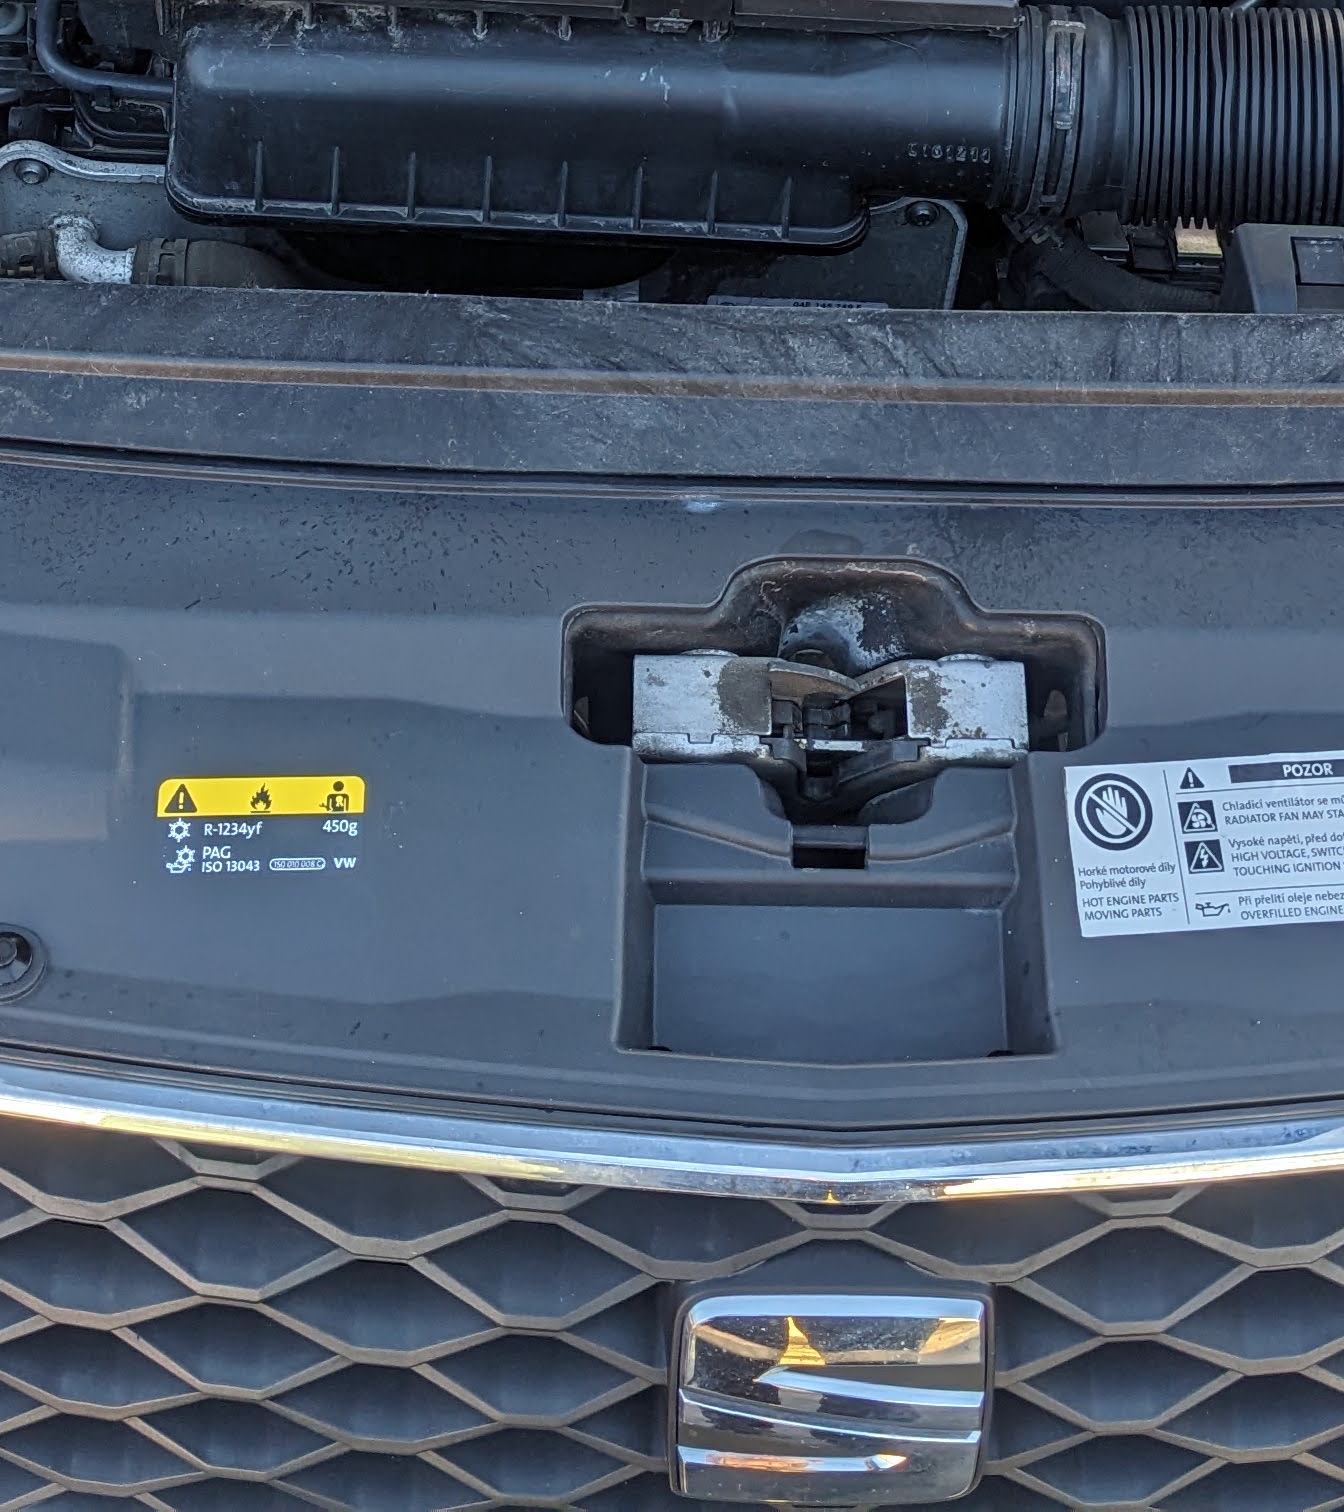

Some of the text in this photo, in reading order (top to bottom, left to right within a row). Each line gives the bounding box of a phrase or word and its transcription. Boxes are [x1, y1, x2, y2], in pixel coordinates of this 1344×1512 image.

[1281, 762, 1333, 778] POZOR
[1264, 796, 1315, 809] ventilátor
[1316, 797, 1329, 806] se
[1223, 812, 1276, 825] RADIATOR
[1278, 811, 1299, 821] FAN
[1301, 809, 1324, 820] MAY
[204, 820, 358, 839] R-1234yf 450g
[1227, 836, 1265, 849] Vysoké
[1266, 833, 1304, 848] napětí,
[1304, 832, 1328, 846] před
[202, 846, 231, 859] PAG
[1230, 851, 1259, 862] HIGH
[1260, 848, 1310, 861] VOLTAGE,
[202, 860, 260, 872] ISO 13043
[334, 857, 356, 869] VW
[1077, 861, 1176, 876] Horké motorové díly
[1232, 864, 1291, 876] TOUCHING
[1292, 861, 1341, 873] IGNITION
[1079, 876, 1147, 892] Pohyblivé díly
[1082, 892, 1179, 907] HOT ENGINE PARTS
[1238, 895, 1252, 907] Při
[1254, 894, 1286, 908] přelití
[1288, 892, 1315, 906] oleje
[1084, 906, 1162, 921] MOVING PARTS
[1240, 906, 1302, 920] OVERFILLED
[1303, 904, 1344, 916] ENGINE
